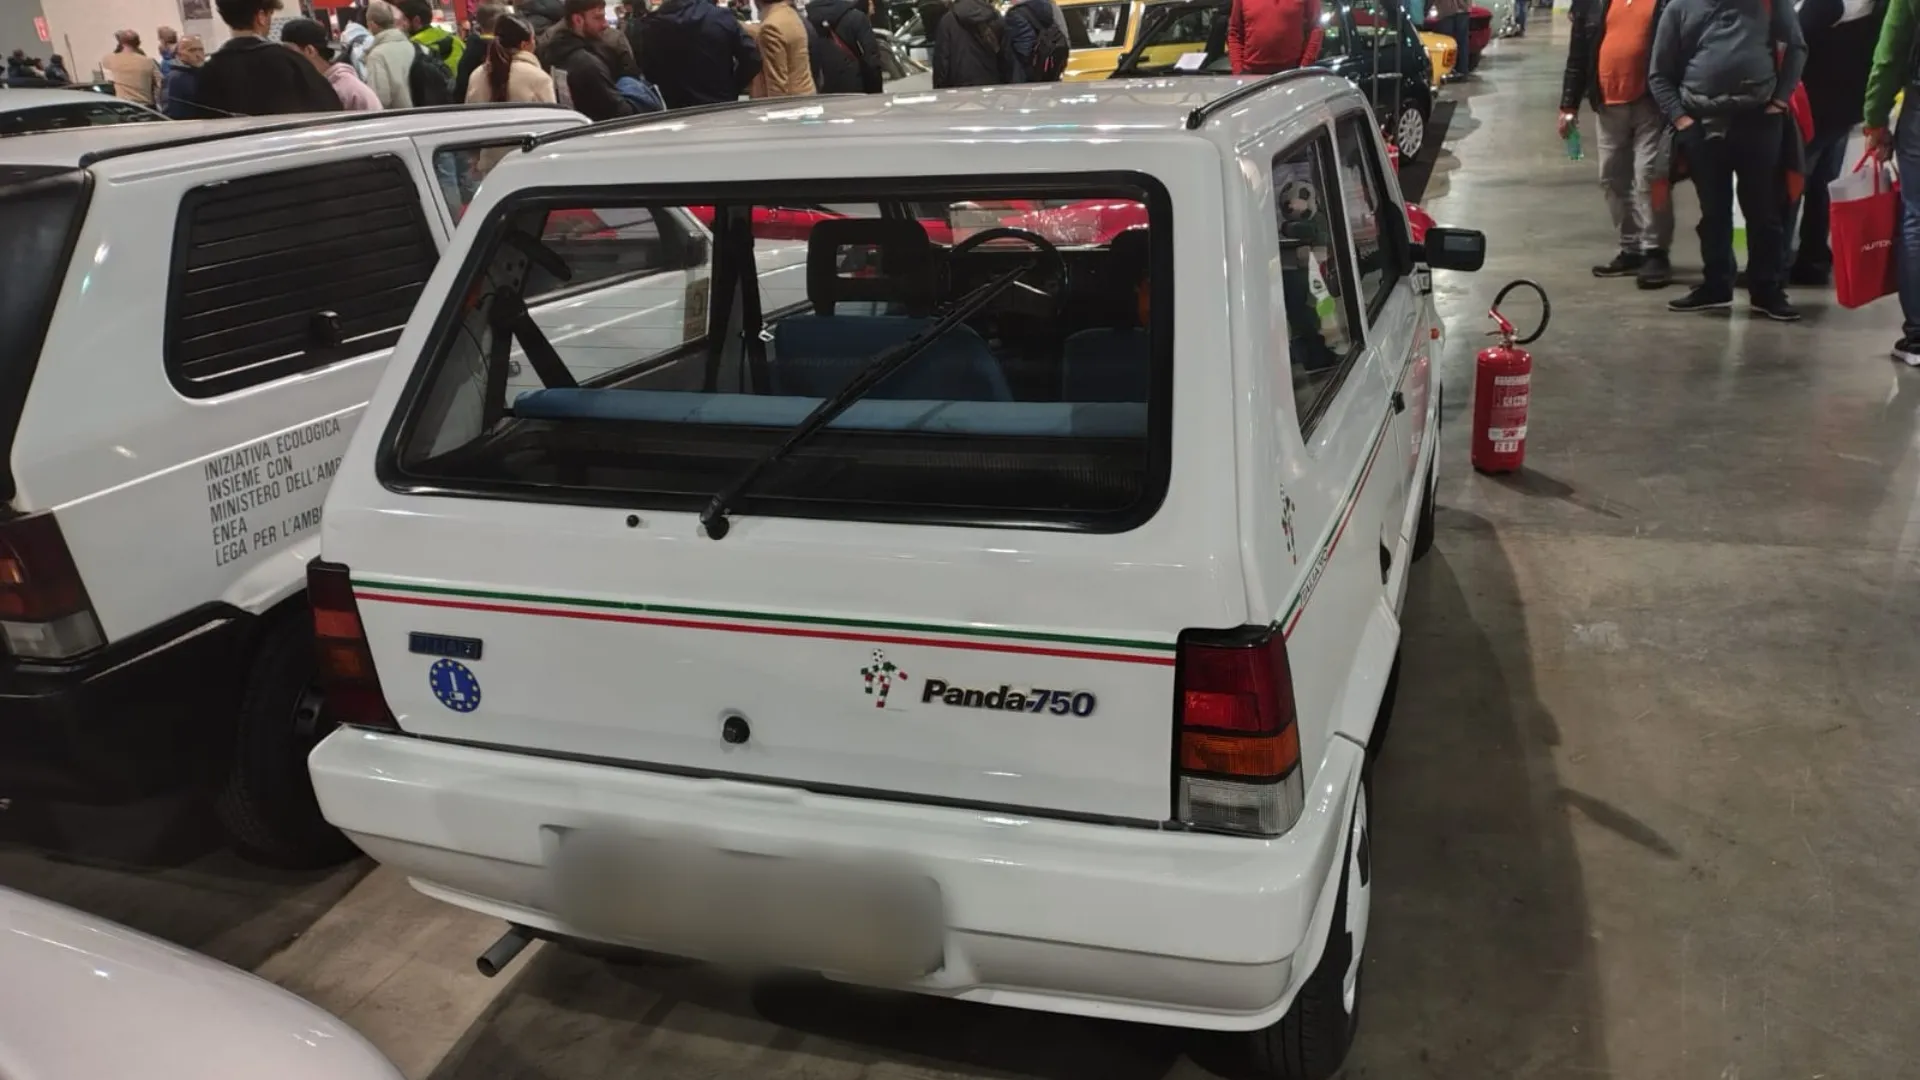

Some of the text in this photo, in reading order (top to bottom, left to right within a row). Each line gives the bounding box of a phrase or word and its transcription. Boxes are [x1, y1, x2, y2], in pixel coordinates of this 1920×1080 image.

[205, 418, 341, 481] INIZIATIVA ECOLOGICA
[207, 455, 293, 501] INSIEME CON
[210, 481, 280, 523] MINISTERO
[213, 517, 247, 545] ENEA
[216, 539, 248, 566] LEGA
[253, 525, 276, 550] PER
[922, 678, 1096, 717] Panda-750
